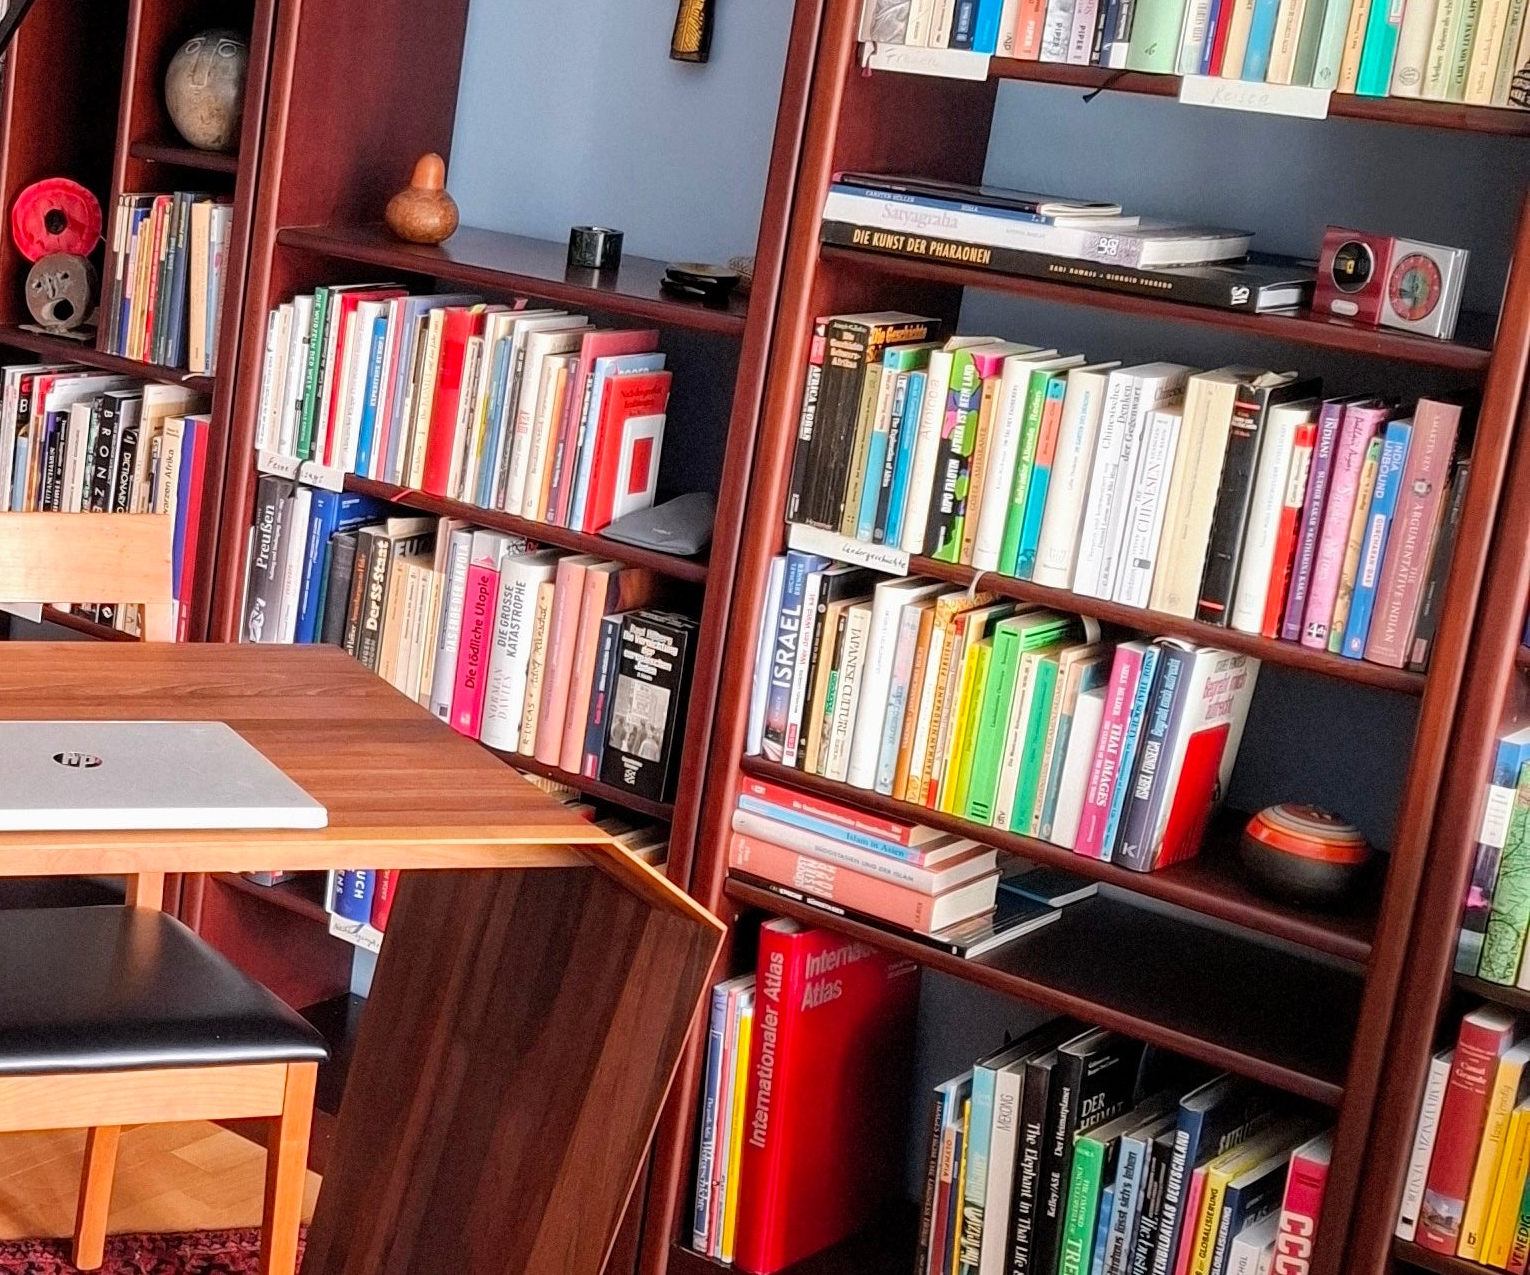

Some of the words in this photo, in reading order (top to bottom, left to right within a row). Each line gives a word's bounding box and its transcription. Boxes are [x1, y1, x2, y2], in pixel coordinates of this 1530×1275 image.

[1055, 22, 1063, 50] PIPER
[1076, 24, 1085, 56] PIPER
[881, 203, 959, 229] Satyagraha
[852, 228, 869, 244] DIE
[872, 232, 906, 251] KUNST
[906, 239, 926, 254] DER
[929, 242, 991, 264] PHARAONEN
[869, 326, 885, 345] Die
[885, 324, 928, 343] Geschichte
[809, 366, 822, 403] AFRICA
[1117, 385, 1131, 424] Denken
[921, 378, 940, 440] Afrotopia
[1101, 382, 1120, 449] Chinesisches
[1125, 386, 1142, 443] Gegenwart
[1319, 417, 1337, 458] INDIANS
[1392, 441, 1405, 472] INDIA
[1375, 440, 1392, 499] UNBOUND
[1137, 460, 1161, 533] CHINESEN
[256, 504, 275, 570] Preußen
[475, 576, 490, 616] Utopie
[502, 585, 514, 627] GROSSE
[366, 607, 378, 631] Der
[498, 629, 508, 647] DIE
[507, 581, 526, 657] KATASTROPHE
[1385, 600, 1402, 644] INDIAN
[446, 633, 457, 653] DAS
[468, 619, 483, 663] tödliche
[772, 604, 802, 688] ISRAEL
[846, 628, 862, 684] JAPANESE
[465, 665, 477, 689] Die
[489, 668, 502, 720] NORMAN
[498, 676, 511, 720] DAVIES
[837, 685, 855, 736] CULTURE
[1107, 723, 1122, 754] THAI
[1141, 741, 1161, 774] FONSECA
[1096, 761, 1115, 806] IMAGES
[1135, 773, 1153, 800] ISABEL
[846, 833, 869, 845] Islam
[880, 842, 905, 857] Asien
[763, 951, 785, 1003] Atlas
[801, 978, 843, 1012] Atlas
[749, 1004, 779, 1149] Internationaler
[997, 1092, 1015, 1133] MEKONG
[1081, 1092, 1106, 1117] DER
[1027, 1123, 1040, 1147] The
[943, 1139, 952, 1177] OLYMPIA
[1021, 1151, 1038, 1202] Elephant
[1165, 1130, 1190, 1204] DEUTSCHLAND
[1199, 1188, 1218, 1260] GLOBALISIERUNG
[1511, 1214, 1530, 1267] VENEDIG
